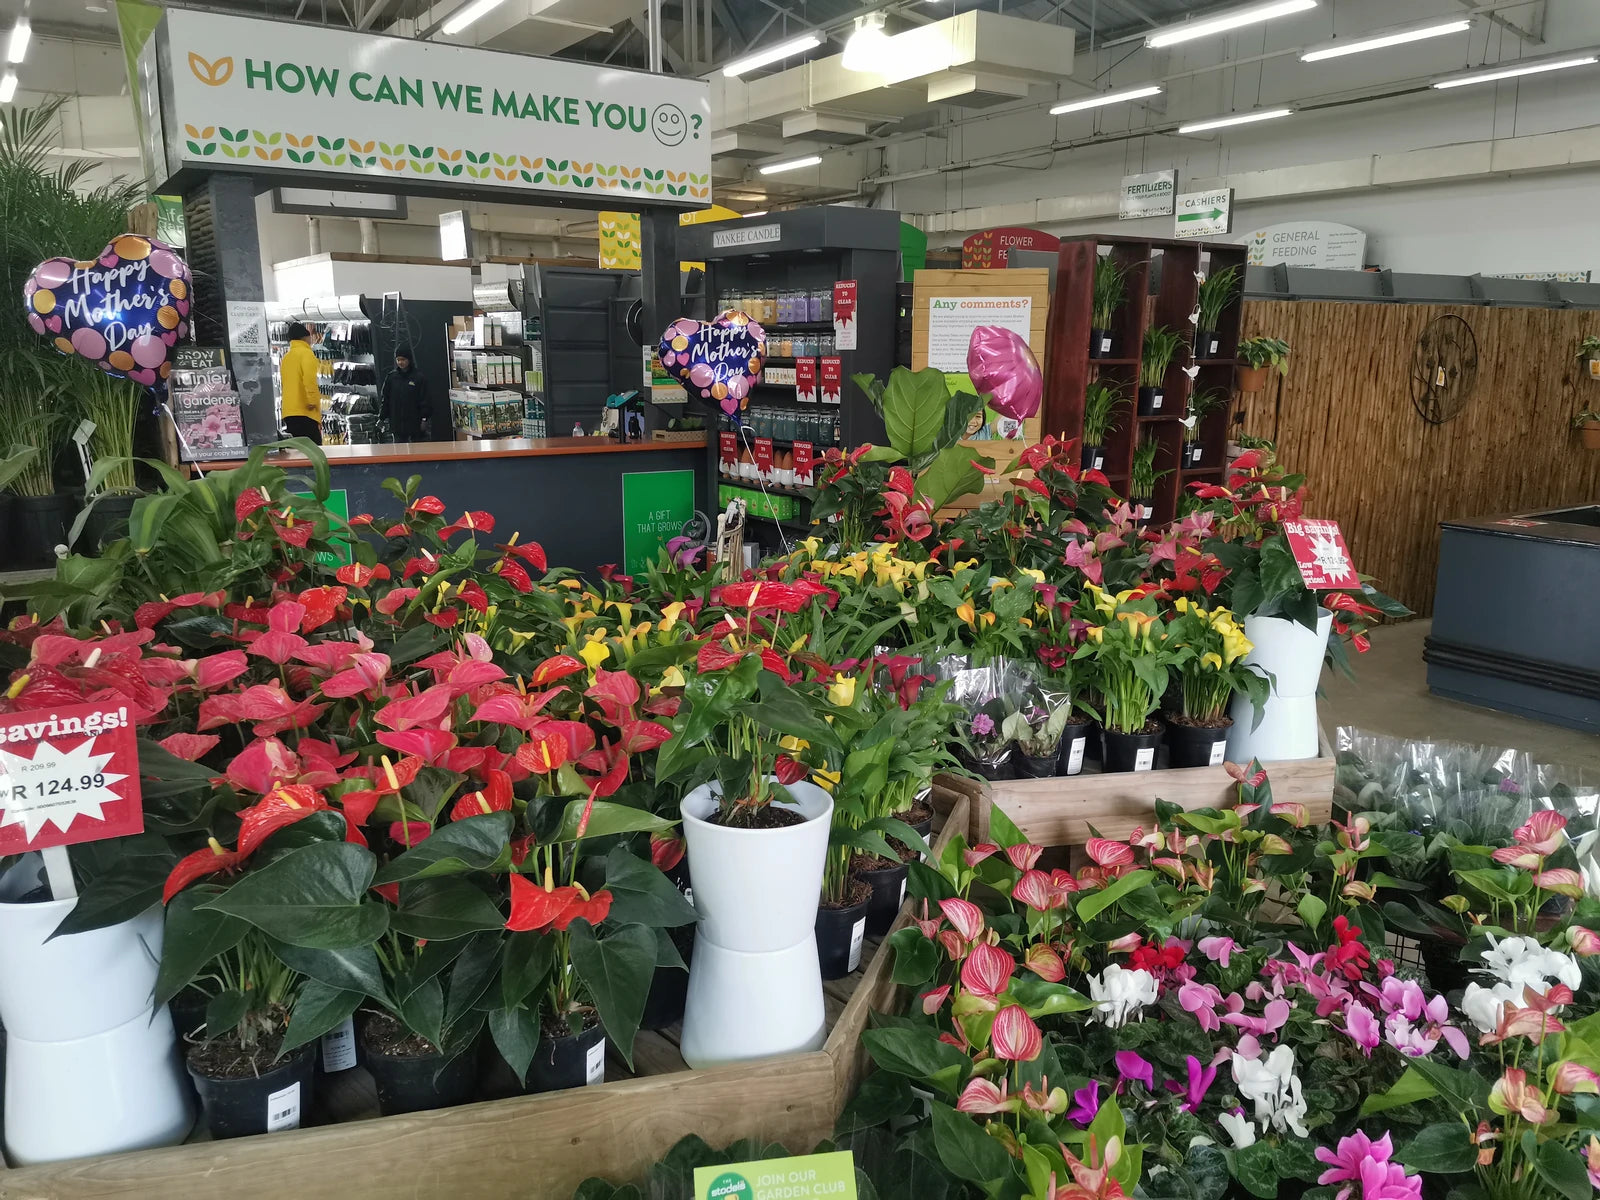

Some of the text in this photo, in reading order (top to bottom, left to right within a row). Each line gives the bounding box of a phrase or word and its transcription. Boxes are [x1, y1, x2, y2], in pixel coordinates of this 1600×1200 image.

[245, 58, 703, 140] HOW CAN WE MAKE YOU ?
[1127, 181, 1173, 195] FERTILIZERS
[1185, 195, 1226, 208] CASHIERS
[715, 227, 780, 246] YANKEE CANDLE
[999, 235, 1034, 247] FLOWER
[1272, 230, 1320, 243] GENERAL
[1272, 245, 1317, 257] FEEDING
[66, 259, 151, 295] Happy
[64, 286, 170, 329] Mother's
[933, 299, 1029, 311] Any comments?
[104, 321, 155, 352] Day
[697, 324, 747, 343] Happy
[176, 350, 214, 360] GROW
[691, 341, 759, 364] Mother's
[191, 359, 214, 368] EAT
[714, 361, 745, 384] Day
[183, 395, 236, 409] gardener
[648, 510, 671, 521] A GIFT
[637, 521, 682, 534] THAT GROWS
[1285, 521, 1305, 537] Big
[21, 761, 57, 773] R 209.99
[11, 773, 105, 801] R 124.99
[756, 1170, 817, 1187] JOIN OUR
[757, 1181, 846, 1200] GARDEN CLUB
